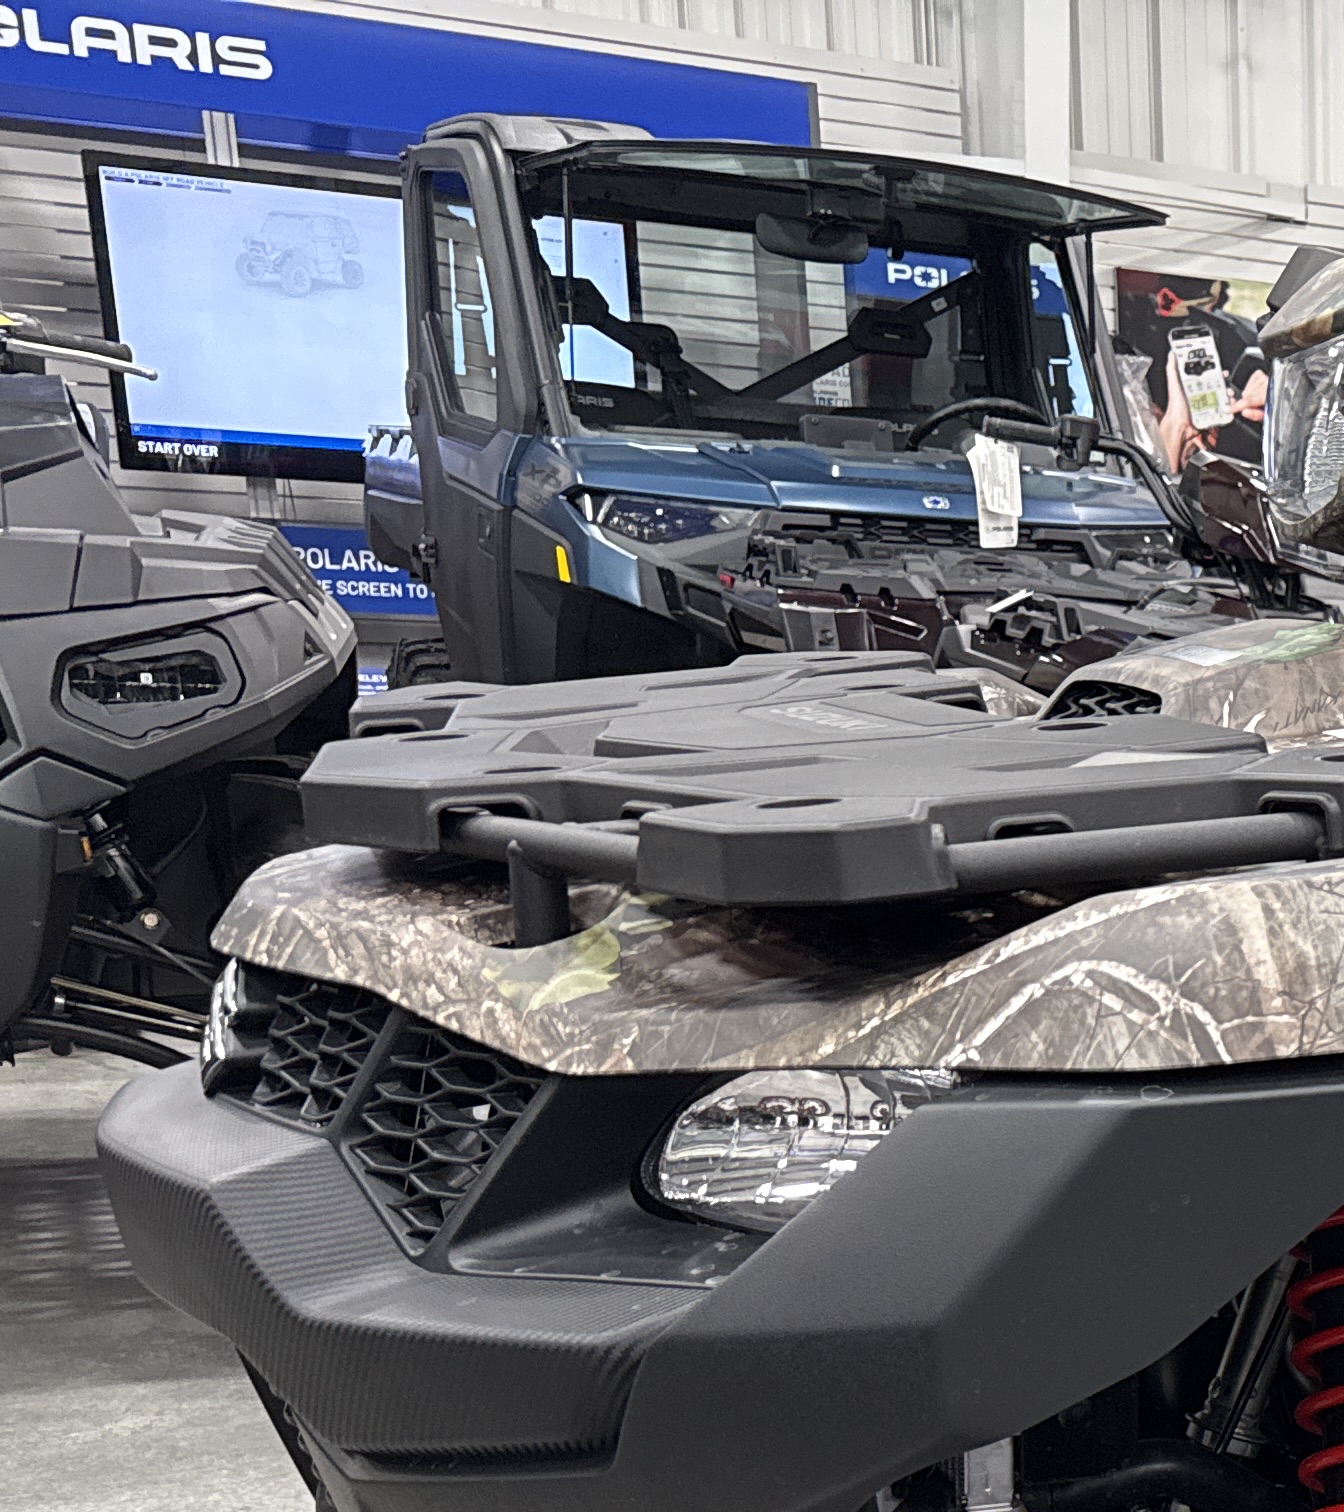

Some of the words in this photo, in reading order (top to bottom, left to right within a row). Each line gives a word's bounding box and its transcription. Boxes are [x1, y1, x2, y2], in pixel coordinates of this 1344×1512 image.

[0, 5, 273, 81] LARIS
[137, 440, 181, 455] START
[182, 443, 219, 457] OVER
[336, 579, 403, 598] SCREEN
[405, 583, 428, 599] TO
